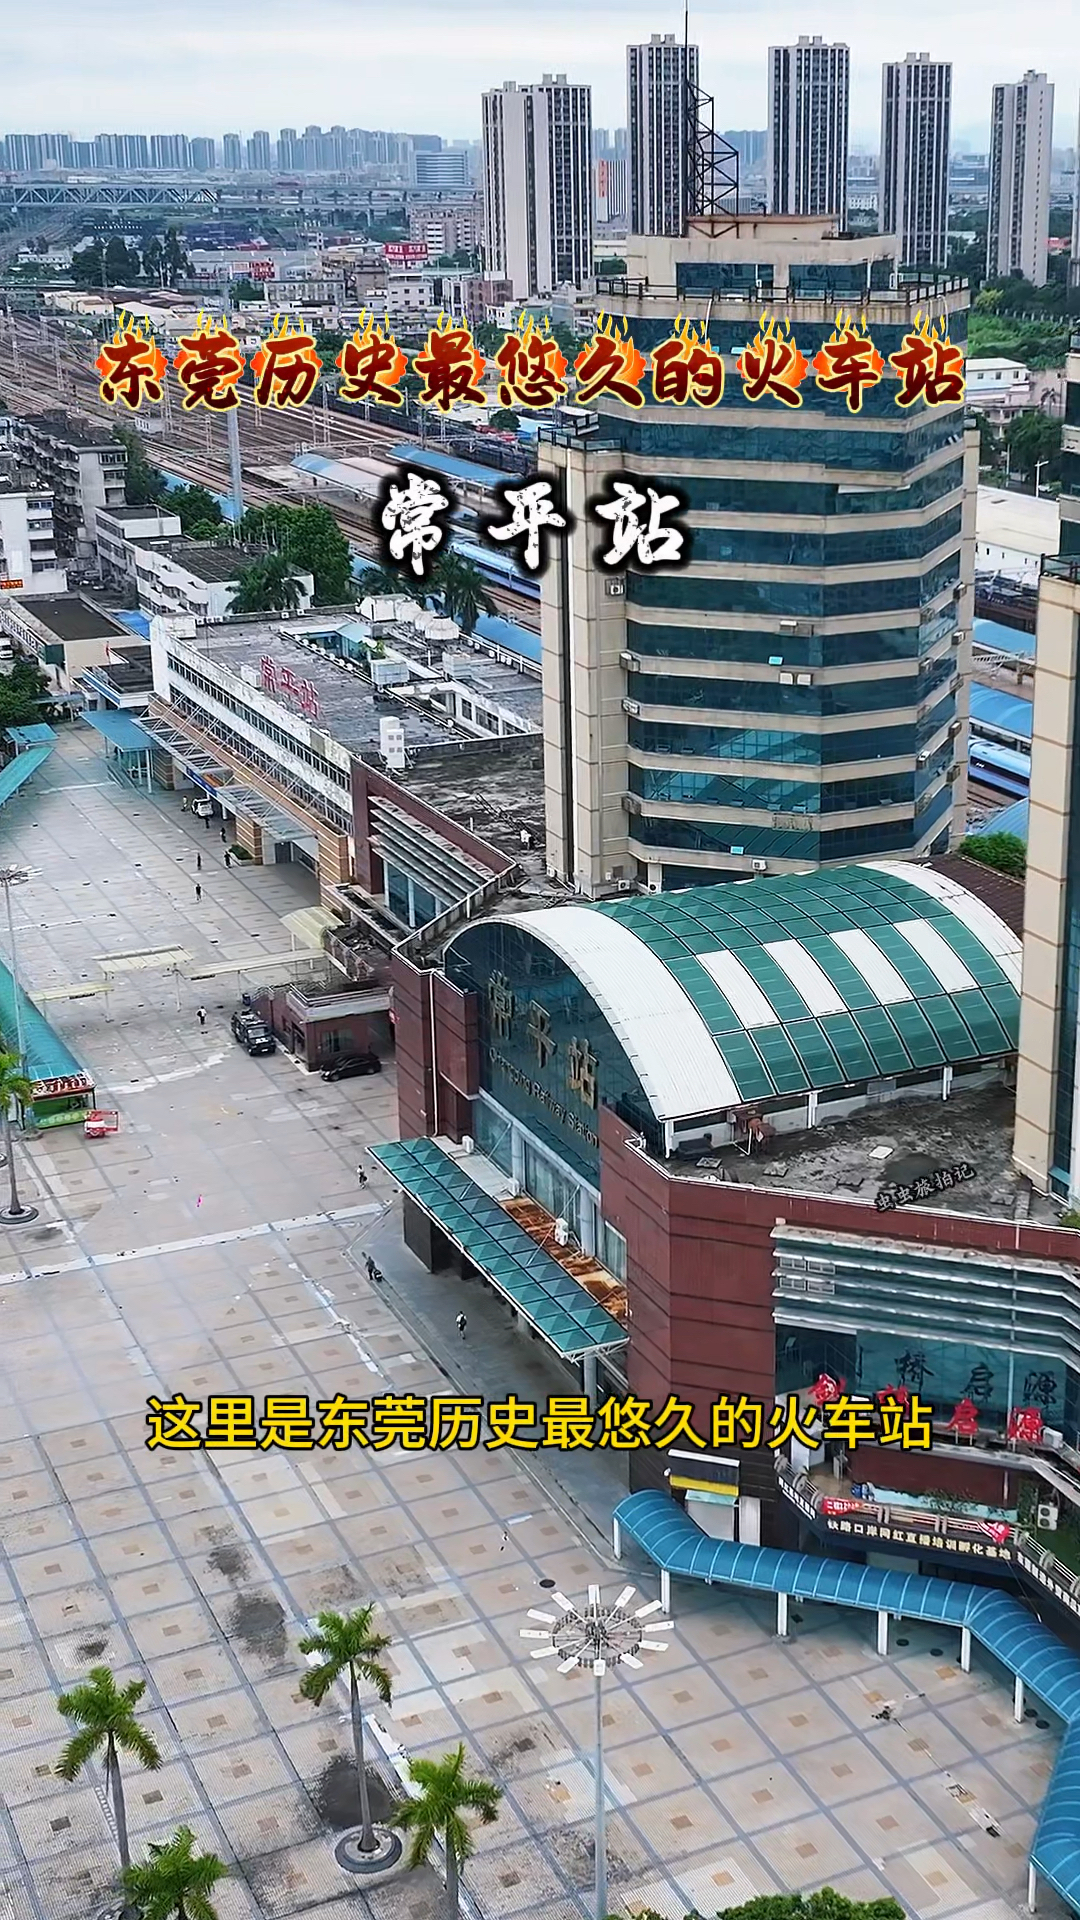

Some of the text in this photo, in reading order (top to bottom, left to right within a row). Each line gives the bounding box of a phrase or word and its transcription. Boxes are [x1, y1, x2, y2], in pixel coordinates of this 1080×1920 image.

[488, 969, 599, 1110] 常平站
[568, 1111, 599, 1149] Station
